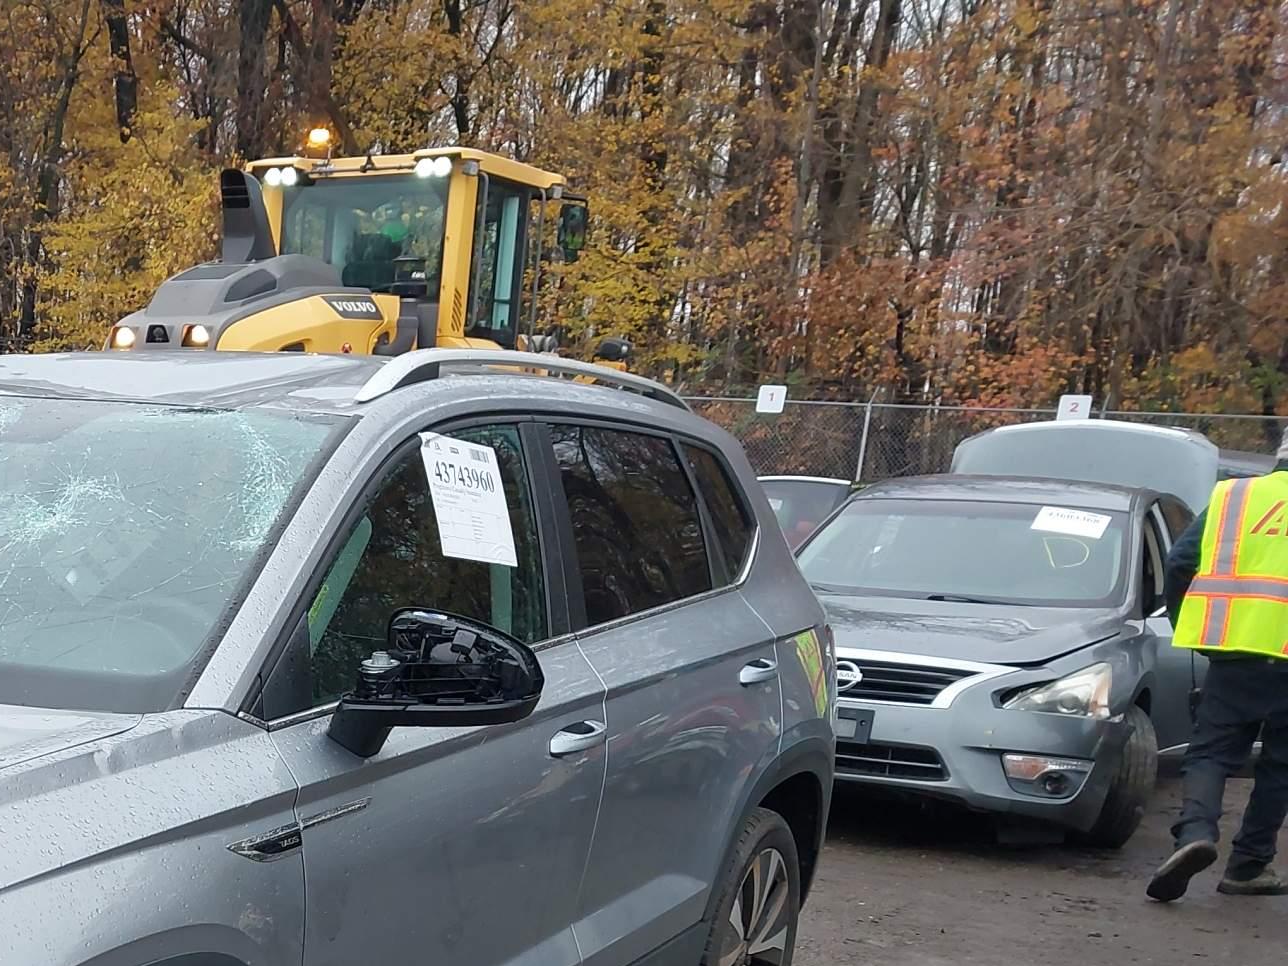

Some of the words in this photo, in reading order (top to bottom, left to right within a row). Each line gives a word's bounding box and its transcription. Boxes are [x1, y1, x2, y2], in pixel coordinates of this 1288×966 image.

[331, 301, 376, 312] VOLVO
[768, 392, 775, 402] 1
[1069, 402, 1079, 413] 2
[434, 460, 495, 493] 43743960
